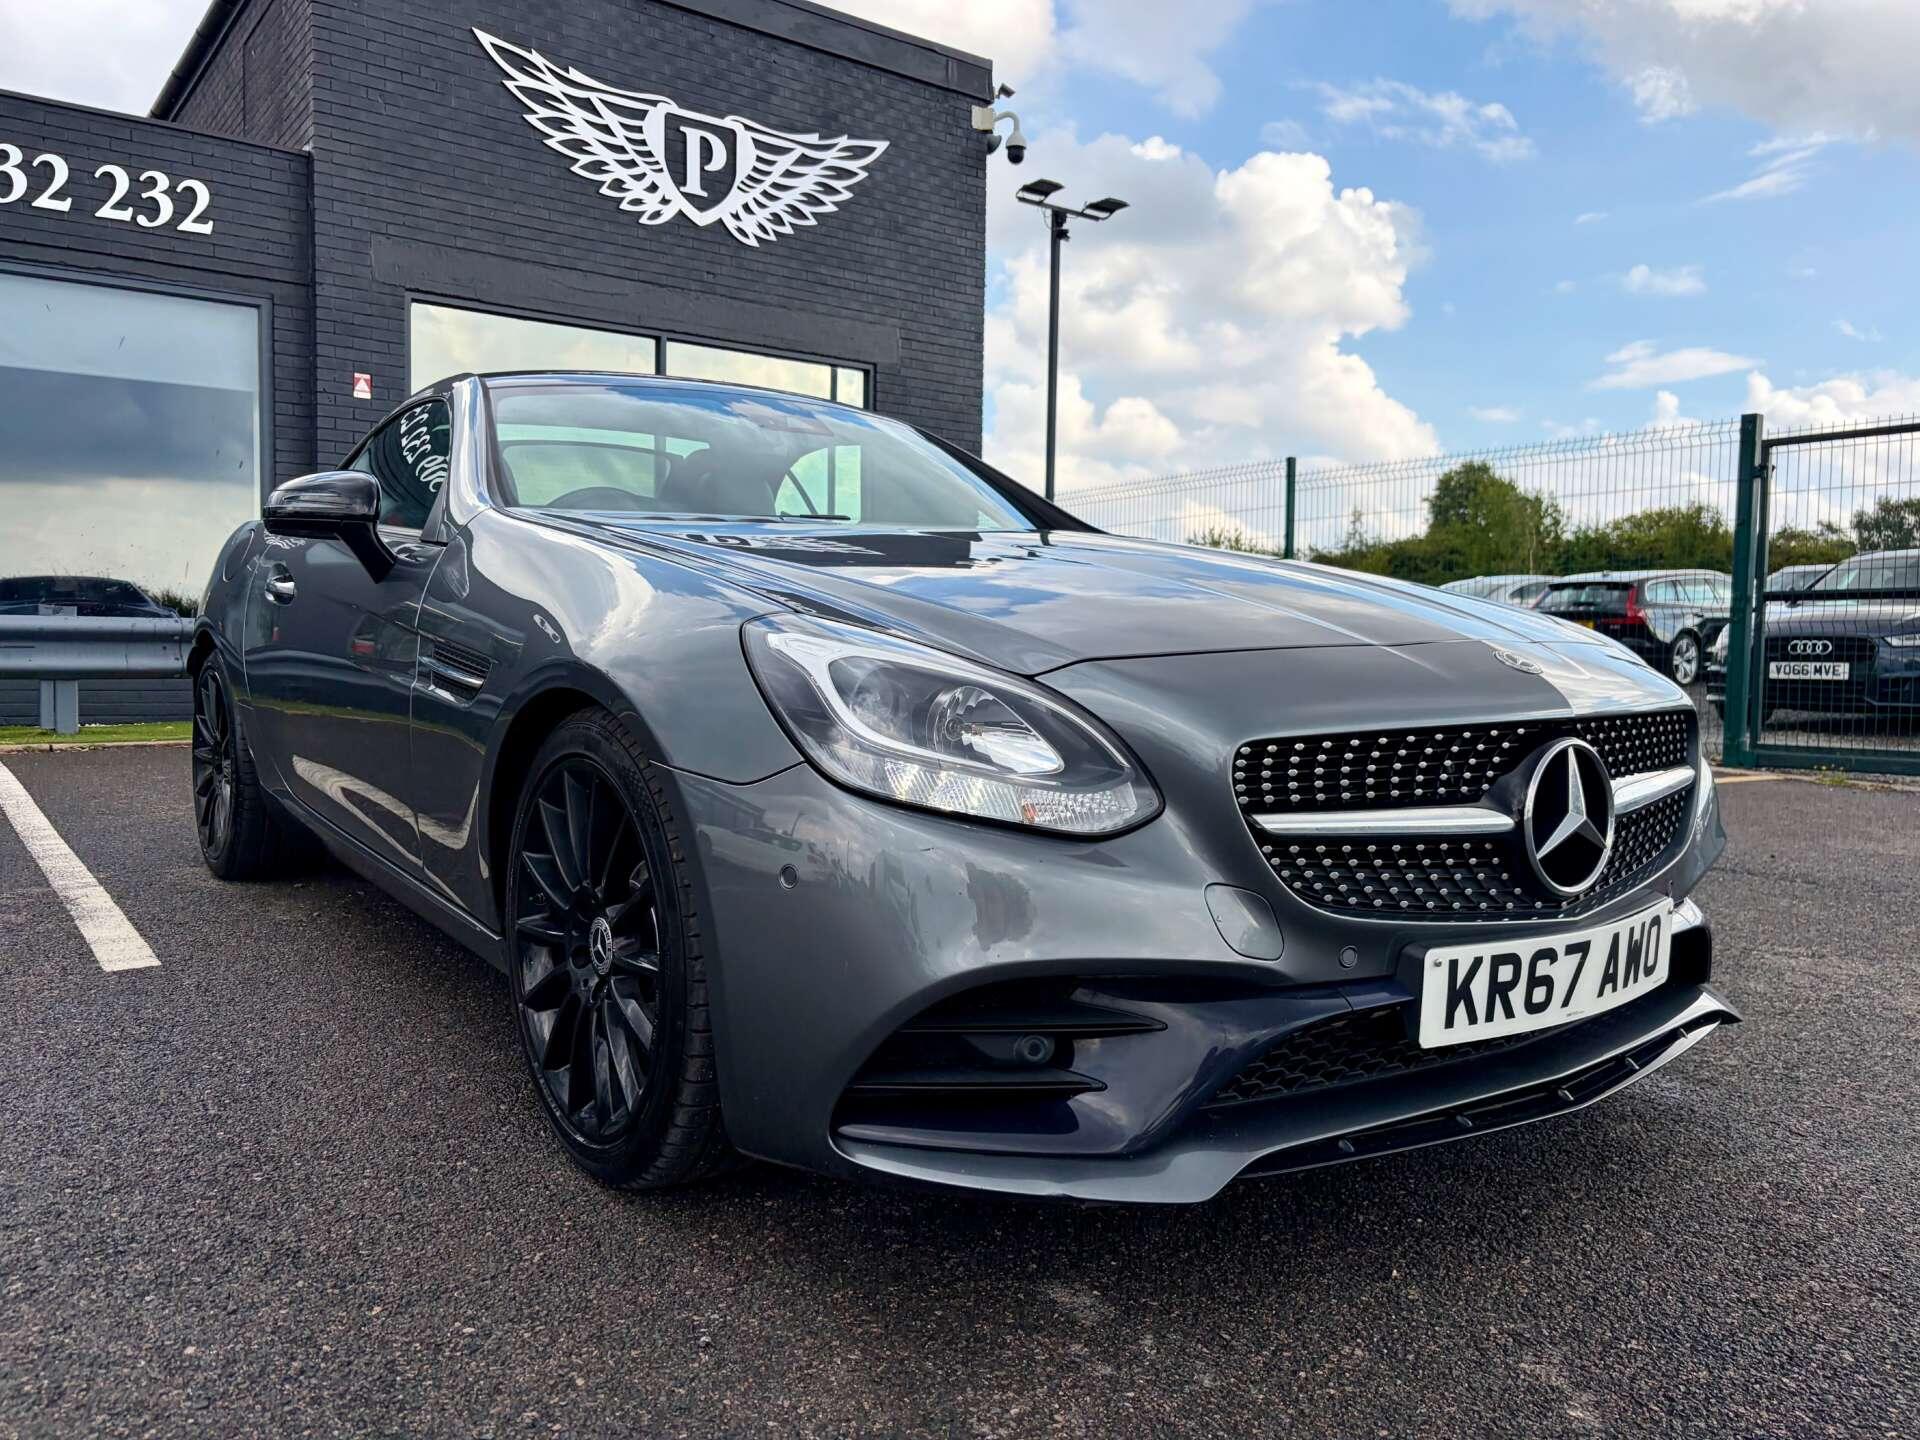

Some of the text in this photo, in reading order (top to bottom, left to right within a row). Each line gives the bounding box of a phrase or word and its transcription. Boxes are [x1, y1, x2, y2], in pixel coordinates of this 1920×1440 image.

[0, 143, 214, 235] 32 232
[679, 126, 727, 197] P
[1775, 664, 1841, 676] VO66 MVE
[1444, 914, 1661, 1030] KR67 AWO
